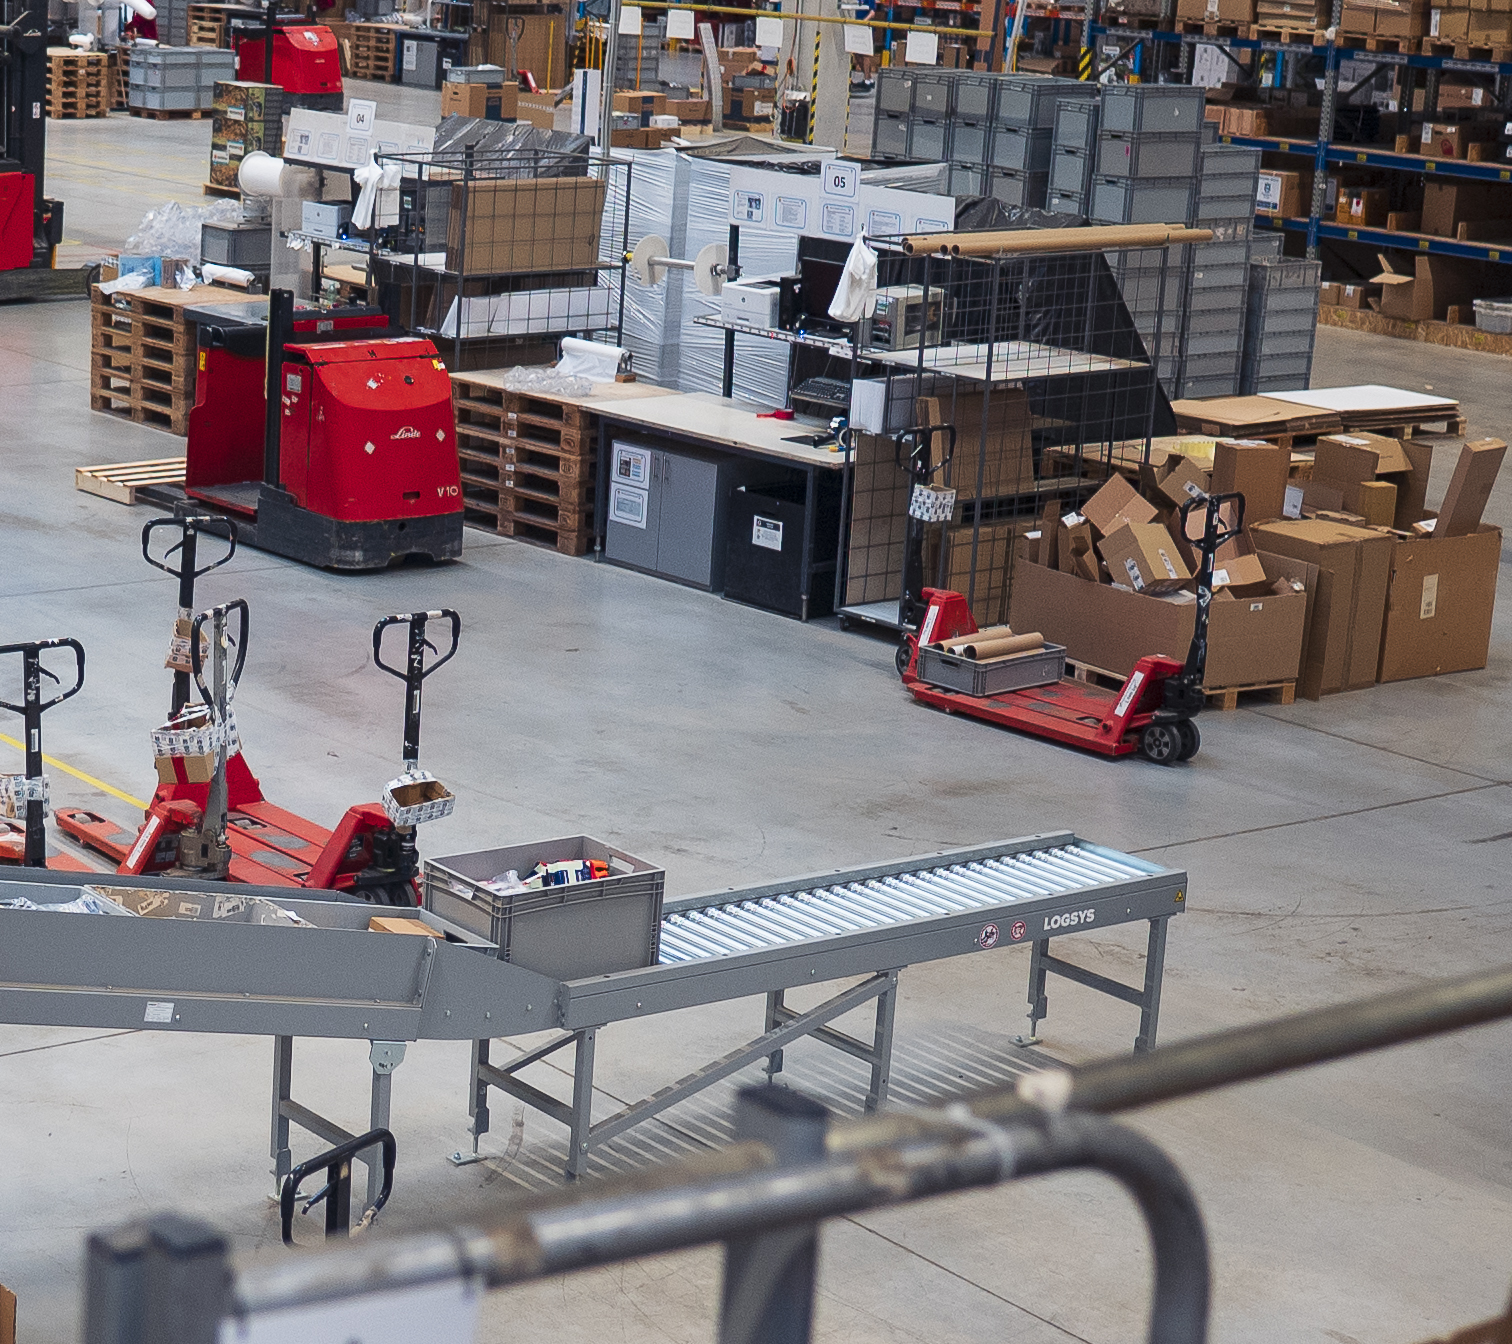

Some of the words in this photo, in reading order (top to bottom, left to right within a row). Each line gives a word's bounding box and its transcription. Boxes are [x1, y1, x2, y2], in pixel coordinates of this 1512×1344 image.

[356, 113, 366, 124] 04
[833, 175, 846, 188] 05
[390, 425, 422, 441] Linde
